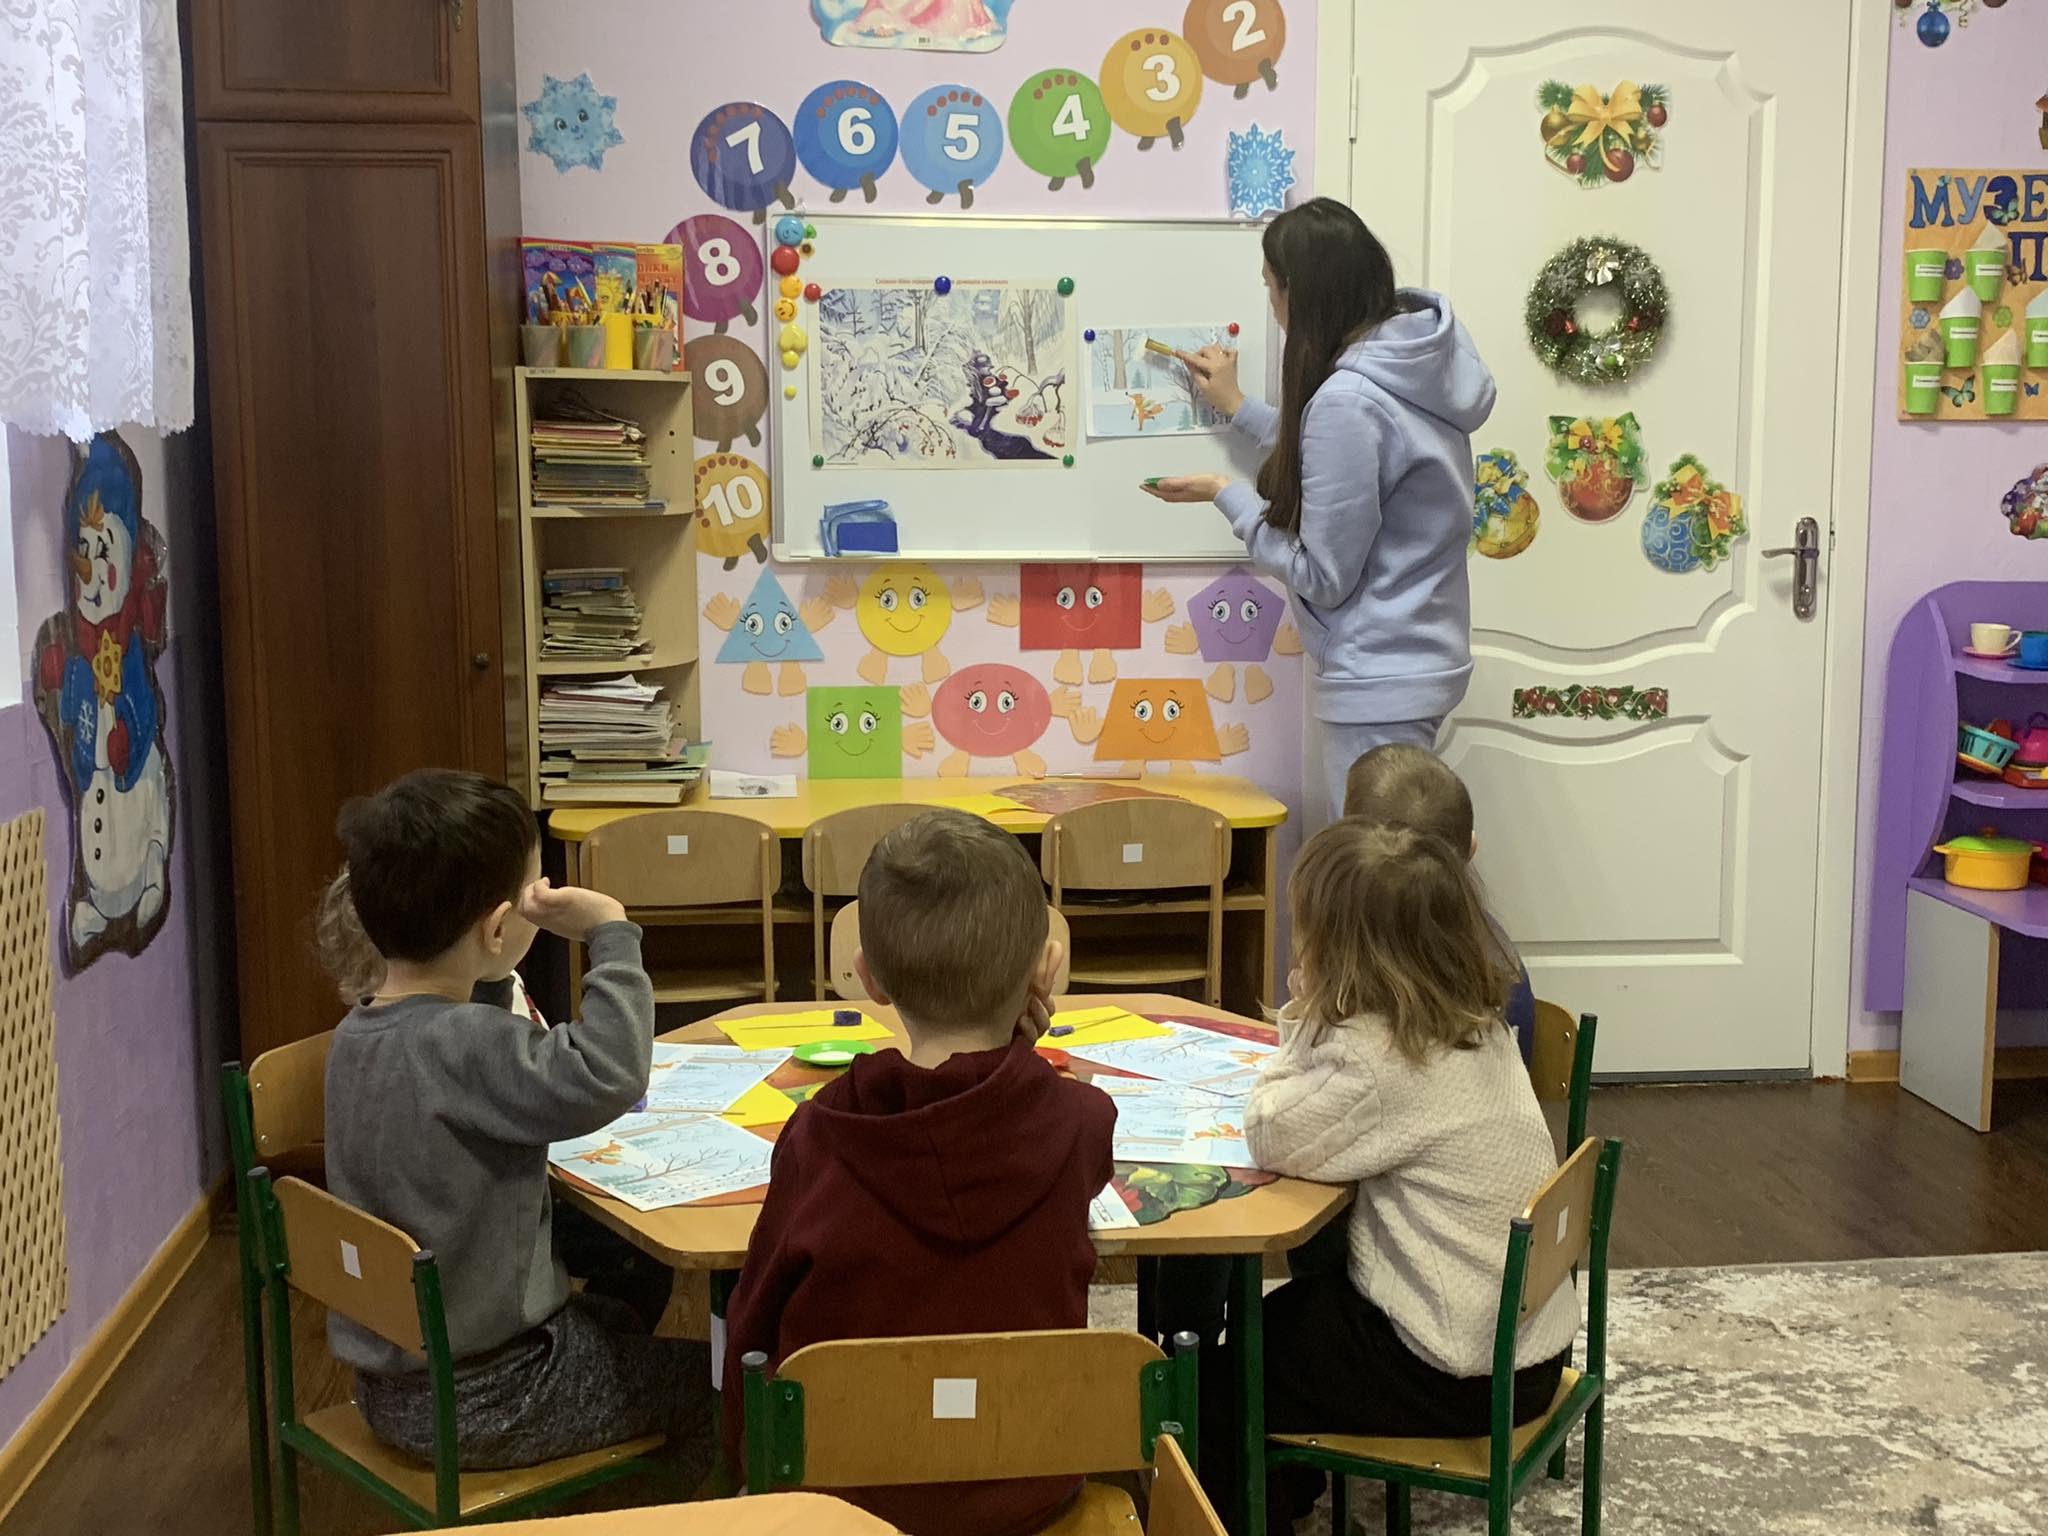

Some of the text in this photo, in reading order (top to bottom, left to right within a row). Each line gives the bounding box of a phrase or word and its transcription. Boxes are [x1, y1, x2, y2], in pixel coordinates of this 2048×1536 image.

[1222, 0, 1266, 52] 2
[1142, 54, 1181, 101] 3
[837, 107, 875, 155] 6
[943, 113, 981, 162] 5
[1052, 94, 1090, 141] 4
[725, 121, 765, 175] 7
[697, 237, 741, 286] 8
[704, 359, 745, 406] 9
[702, 475, 762, 526] 10
